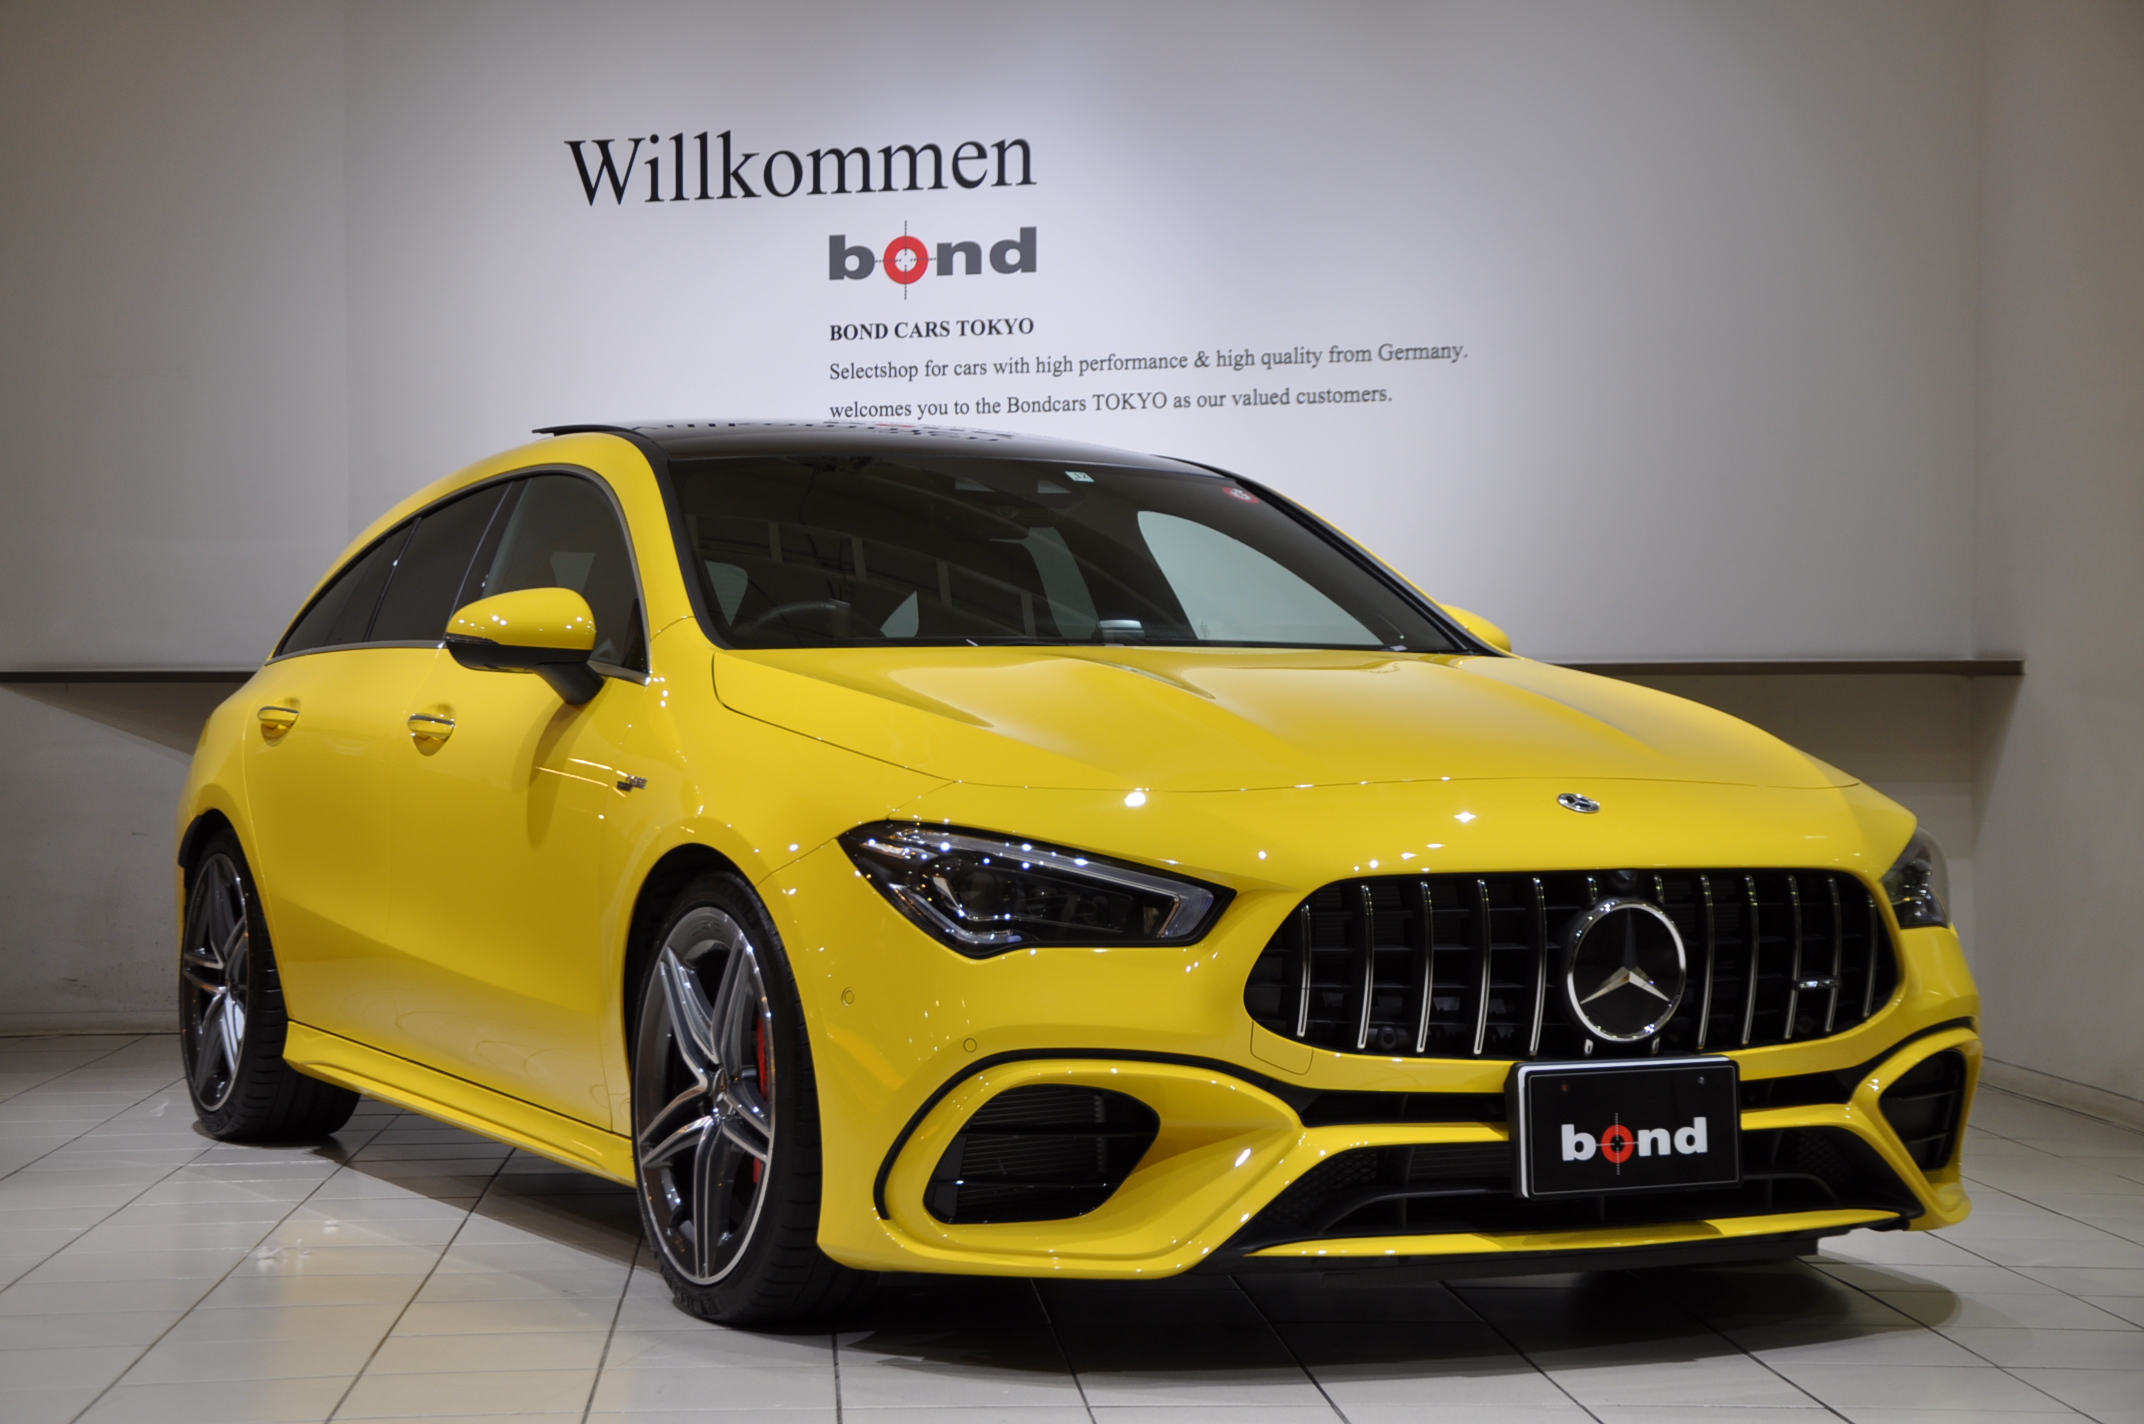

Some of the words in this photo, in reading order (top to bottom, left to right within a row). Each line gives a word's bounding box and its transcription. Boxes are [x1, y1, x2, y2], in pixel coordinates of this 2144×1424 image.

[564, 130, 1037, 206] Willkommen
[829, 226, 1037, 284] bond
[830, 322, 888, 341] BOND
[894, 320, 950, 339] CARS
[956, 317, 1034, 337] TOKYO
[830, 361, 918, 382] Selectshop
[925, 359, 949, 377] for
[954, 363, 987, 376] cars
[993, 357, 1030, 375] with
[1036, 355, 1073, 377] high
[1079, 353, 1188, 376] performance
[1194, 351, 1210, 368] &
[1216, 349, 1255, 371] high
[1261, 346, 1323, 370] quality
[1329, 345, 1372, 363] from
[1378, 343, 1468, 363] Germany.
[830, 399, 911, 418] welcomes
[917, 403, 948, 421] you
[954, 398, 970, 415] to
[976, 396, 1001, 414] the
[1007, 394, 1086, 413] Bondcars
[1092, 392, 1167, 411] TOKYO
[1173, 396, 1191, 409] as
[1197, 395, 1227, 408] our
[1231, 387, 1291, 406] valued
[1296, 388, 1392, 404] customers.
[1561, 1116, 1708, 1164] bond
